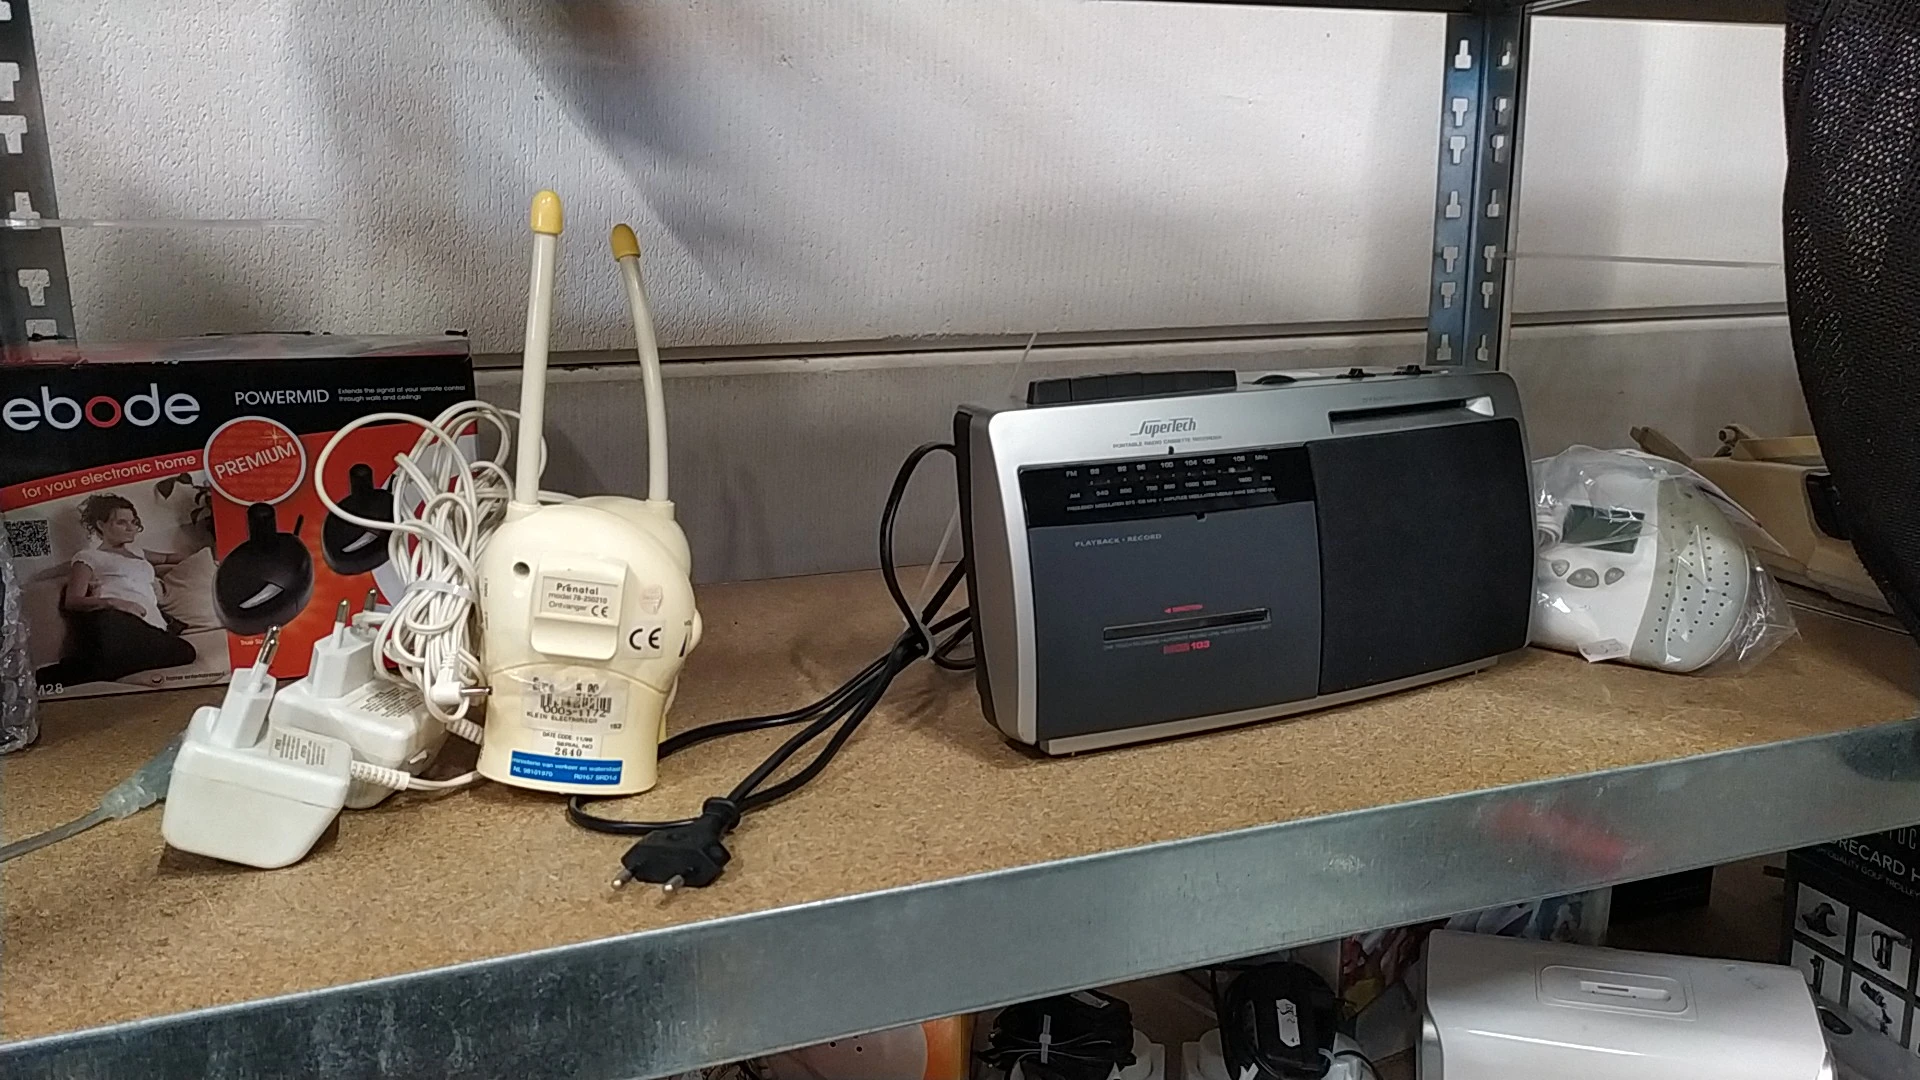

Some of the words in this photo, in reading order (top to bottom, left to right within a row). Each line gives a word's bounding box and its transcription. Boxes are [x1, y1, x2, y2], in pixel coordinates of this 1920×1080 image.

[376, 386, 396, 395] signal
[444, 384, 466, 392] control
[234, 389, 330, 405] POWERMID
[338, 395, 365, 403] through
[2, 382, 201, 431] ebode
[214, 442, 297, 480] PREMIUM
[22, 485, 42, 499] for
[45, 477, 77, 497] your
[80, 462, 153, 486] electronic
[154, 454, 197, 472] home
[1066, 470, 1078, 478] FM
[1074, 537, 1120, 548] PLAYBACK
[1127, 533, 1162, 542] RECORD
[547, 592, 572, 601] model
[548, 600, 588, 612] Ontvanger
[628, 626, 662, 650] CE
[526, 711, 548, 719] KLEIN
[542, 730, 556, 739] DATE
[557, 732, 572, 741] CODE
[554, 747, 583, 757] 2640
[541, 761, 554, 769] van
[554, 763, 579, 772] verkeer
[1830, 839, 1906, 876] RECARD
